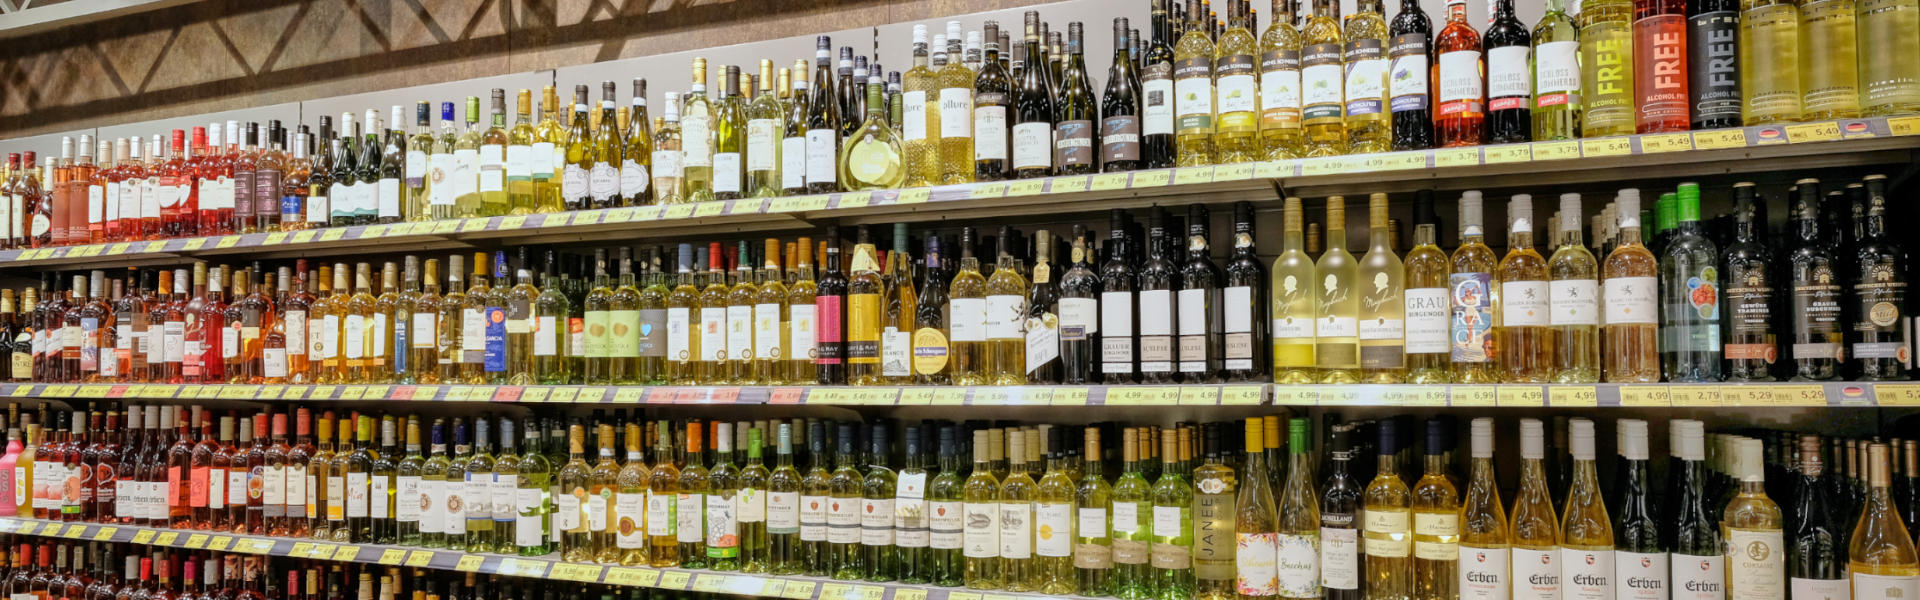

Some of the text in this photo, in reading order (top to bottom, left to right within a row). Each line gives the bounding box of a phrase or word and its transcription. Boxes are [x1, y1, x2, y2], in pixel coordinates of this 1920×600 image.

[1653, 32, 1680, 90] FREE
[1707, 29, 1735, 88] FREE
[1597, 39, 1623, 95] FREE
[1646, 94, 1675, 103] ALCOHOL
[1700, 92, 1730, 100] ALCOHOL
[943, 99, 968, 110] allure
[1590, 99, 1617, 108] ALCOHOL
[1816, 128, 1838, 136] 5,49
[1668, 138, 1690, 146] 5,49
[1722, 134, 1743, 142] 5,49
[1558, 146, 1578, 154] 3,79
[1609, 142, 1630, 151] 5,49
[1408, 296, 1445, 309] GRAU
[1242, 391, 1260, 399] 4,99
[1298, 391, 1316, 399] 4,99
[1474, 391, 1494, 399] 6,99
[1522, 391, 1542, 399] 4,99
[1575, 391, 1595, 399] 4,99
[1647, 391, 1668, 399] 4,99
[1698, 391, 1720, 399] 2,79
[1749, 391, 1772, 399] 5,29
[1801, 391, 1825, 399] 5,29
[1906, 391, 1920, 399] 5,2
[1466, 570, 1498, 583] Erben
[1529, 572, 1559, 585] Erben
[1573, 572, 1606, 586] Erben
[1627, 577, 1661, 589] Erben
[1685, 580, 1720, 592] Erben
